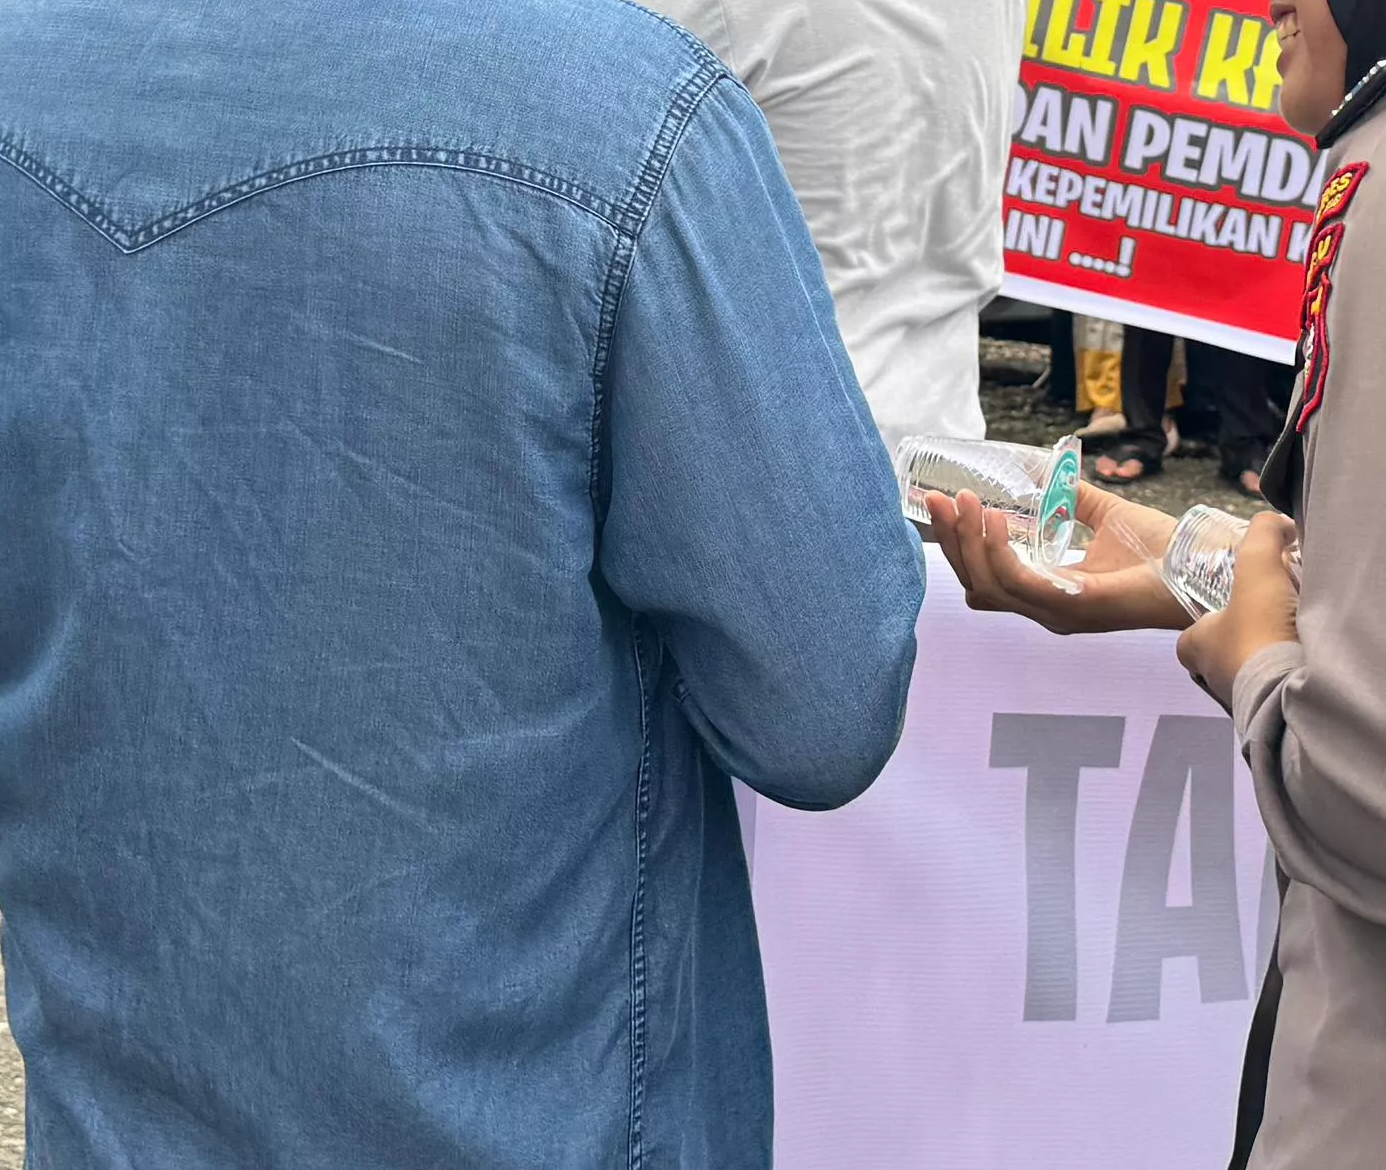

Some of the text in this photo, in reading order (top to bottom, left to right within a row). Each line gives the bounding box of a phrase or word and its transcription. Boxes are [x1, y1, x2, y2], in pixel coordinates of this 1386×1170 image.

[1004, 210, 1065, 260] INI
[1007, 157, 1281, 257] KEPEMILIKAN
[989, 712, 1280, 1024] TA
